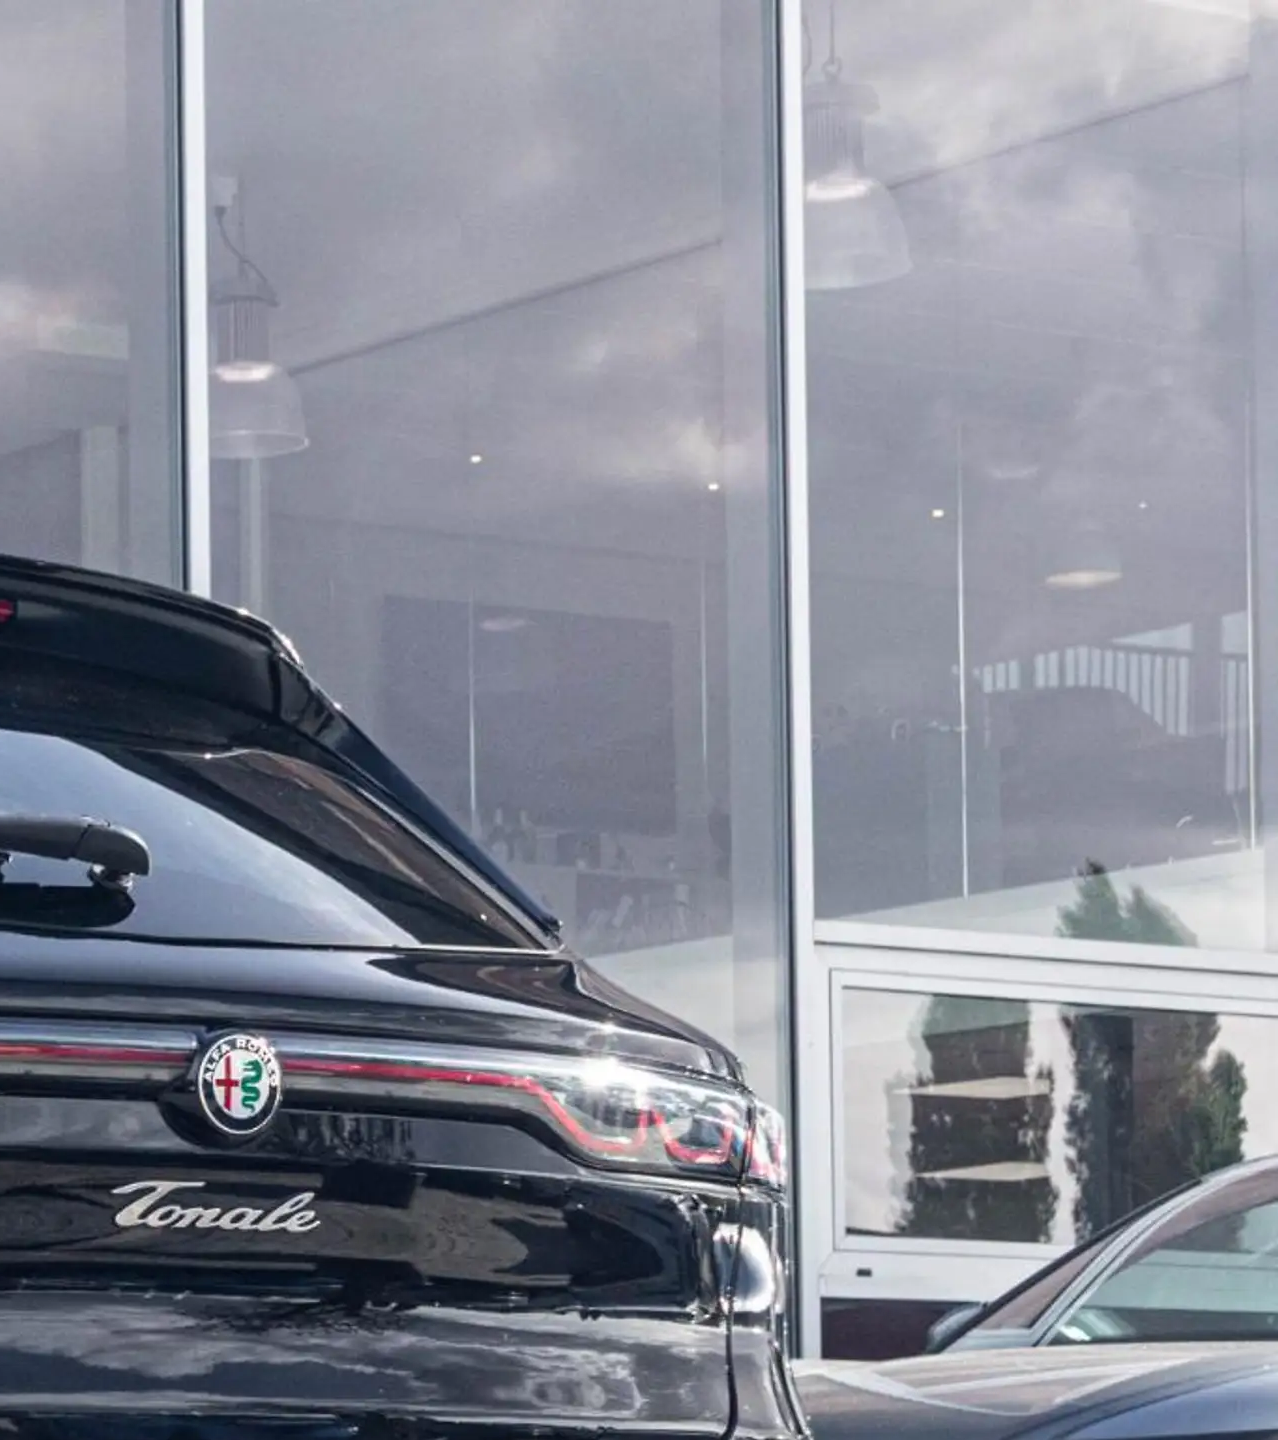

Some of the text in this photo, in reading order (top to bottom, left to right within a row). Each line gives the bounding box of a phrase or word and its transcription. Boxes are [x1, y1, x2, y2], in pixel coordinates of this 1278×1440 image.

[203, 1038, 278, 1088] ALFA ROMEO
[111, 1181, 321, 1234] Tonale
